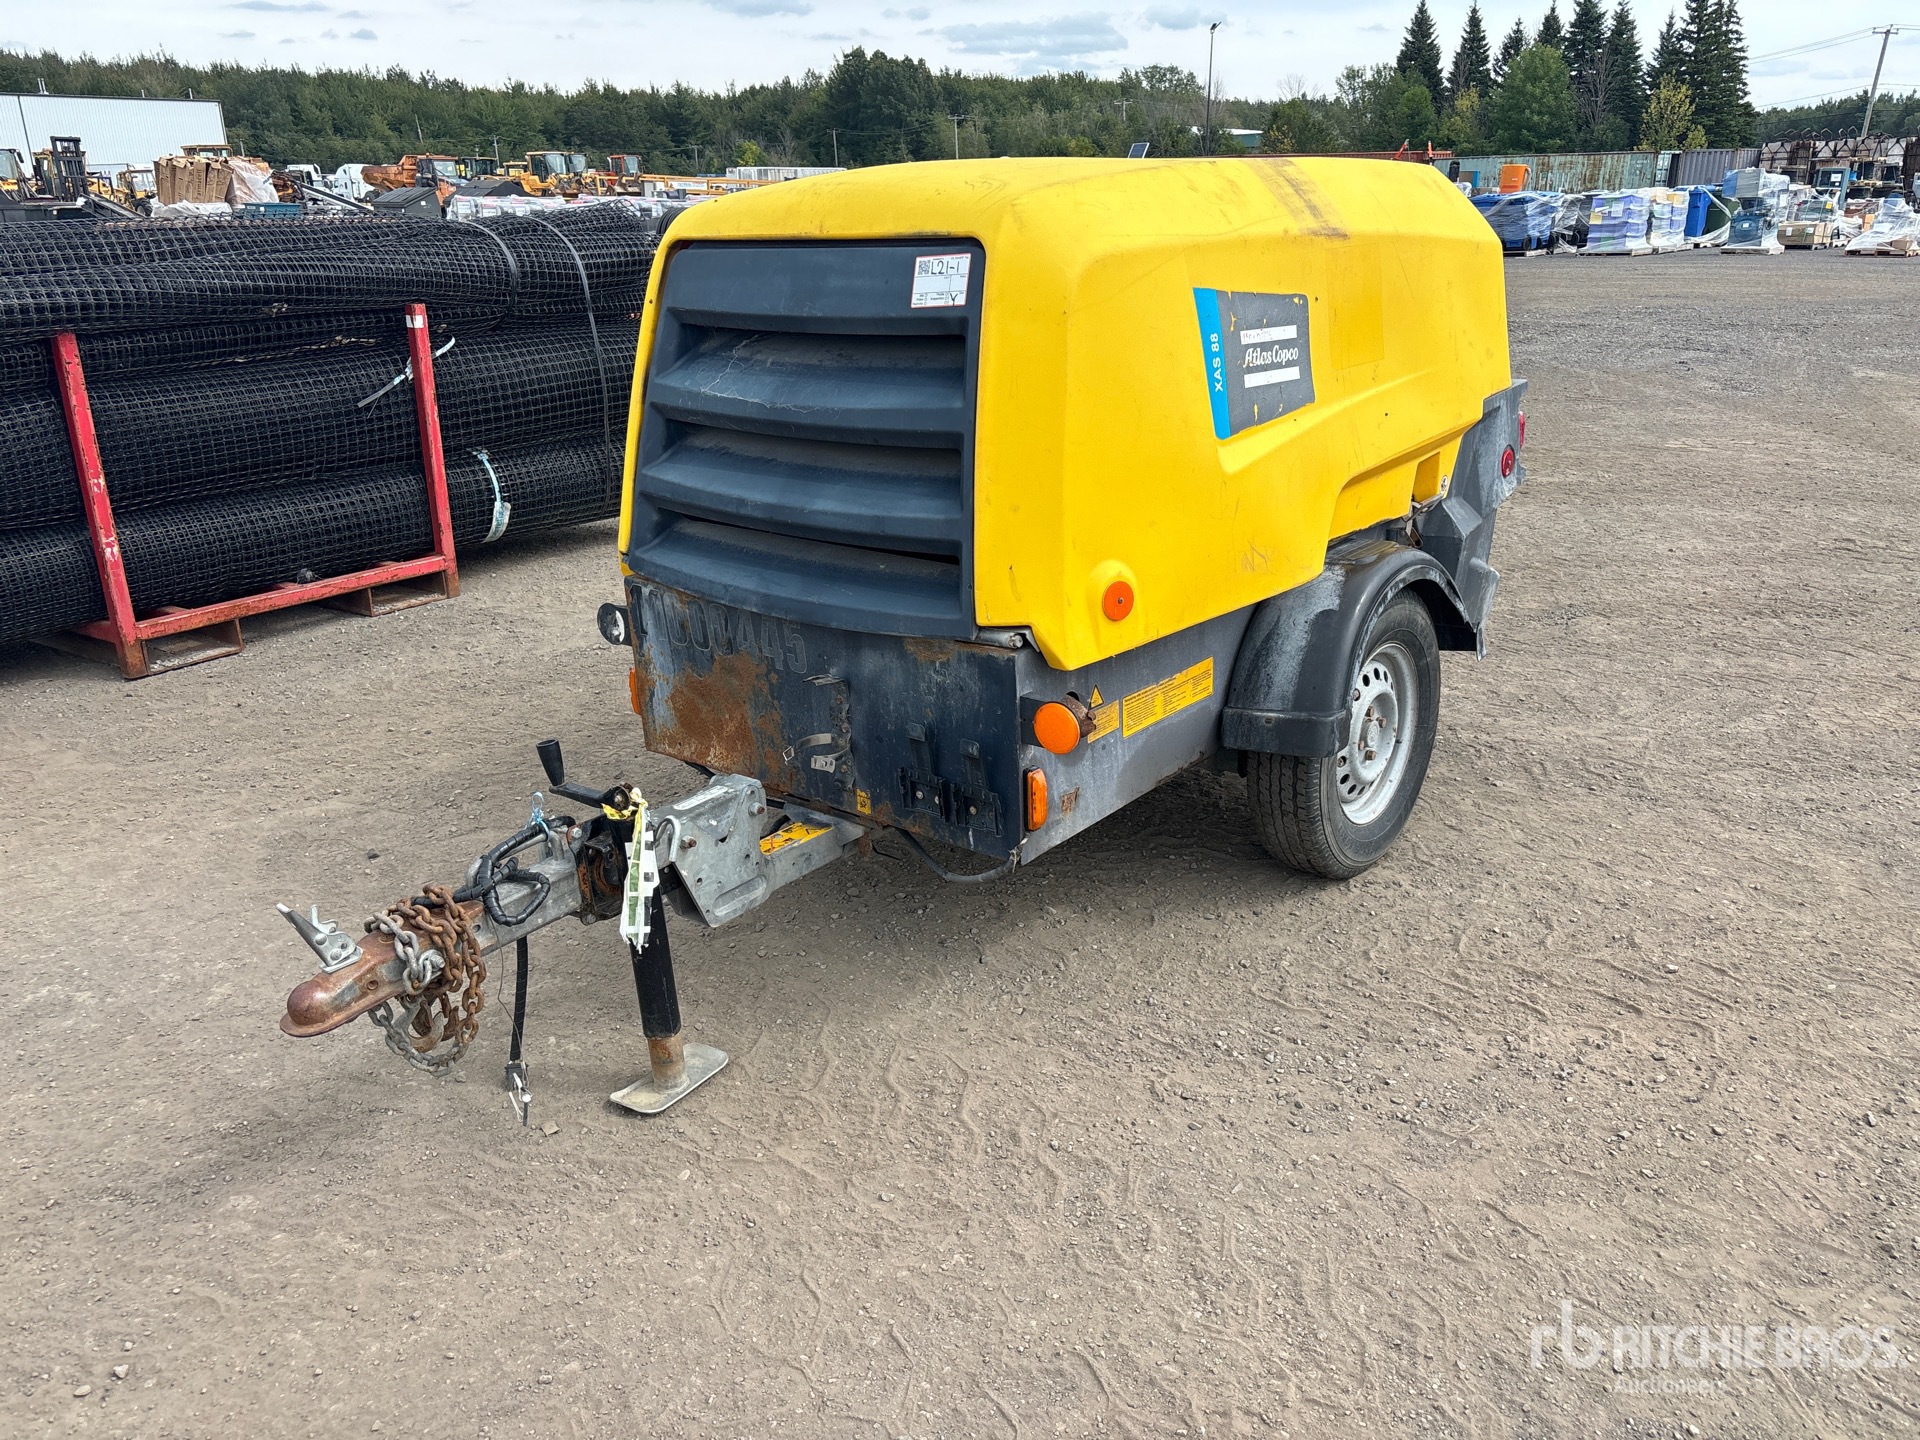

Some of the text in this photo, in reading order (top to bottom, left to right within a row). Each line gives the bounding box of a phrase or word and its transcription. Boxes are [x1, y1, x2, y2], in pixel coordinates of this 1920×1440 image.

[1210, 332, 1224, 393] XAS 88
[1242, 344, 1299, 368] Atlas Copco
